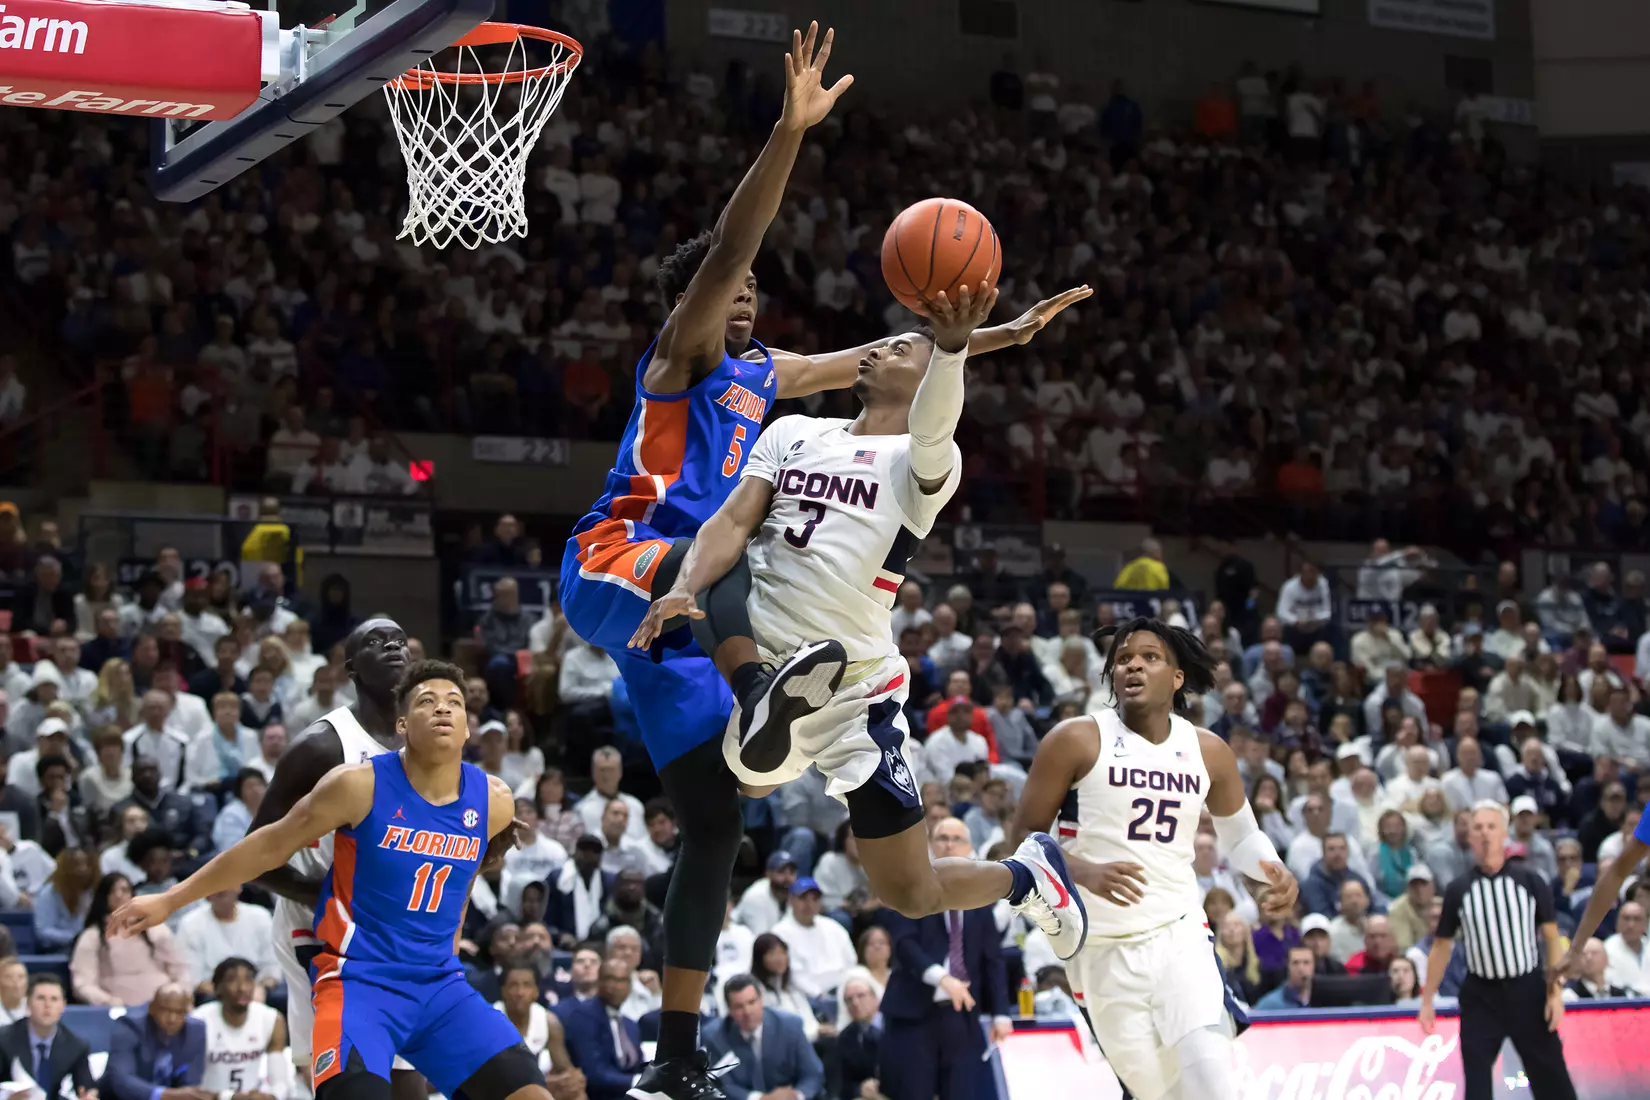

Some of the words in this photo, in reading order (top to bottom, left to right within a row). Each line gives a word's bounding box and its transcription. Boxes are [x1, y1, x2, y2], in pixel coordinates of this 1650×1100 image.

[0, 4, 88, 54] arm
[42, 90, 215, 117] Farm
[721, 423, 747, 478] 5
[783, 500, 827, 549] 3
[1108, 766, 1201, 795] UCONN
[463, 809, 479, 828] SEC
[1127, 797, 1181, 844] 25
[377, 824, 481, 862] FLORIDA
[406, 861, 453, 913] 11
[229, 1068, 244, 1093] 5
